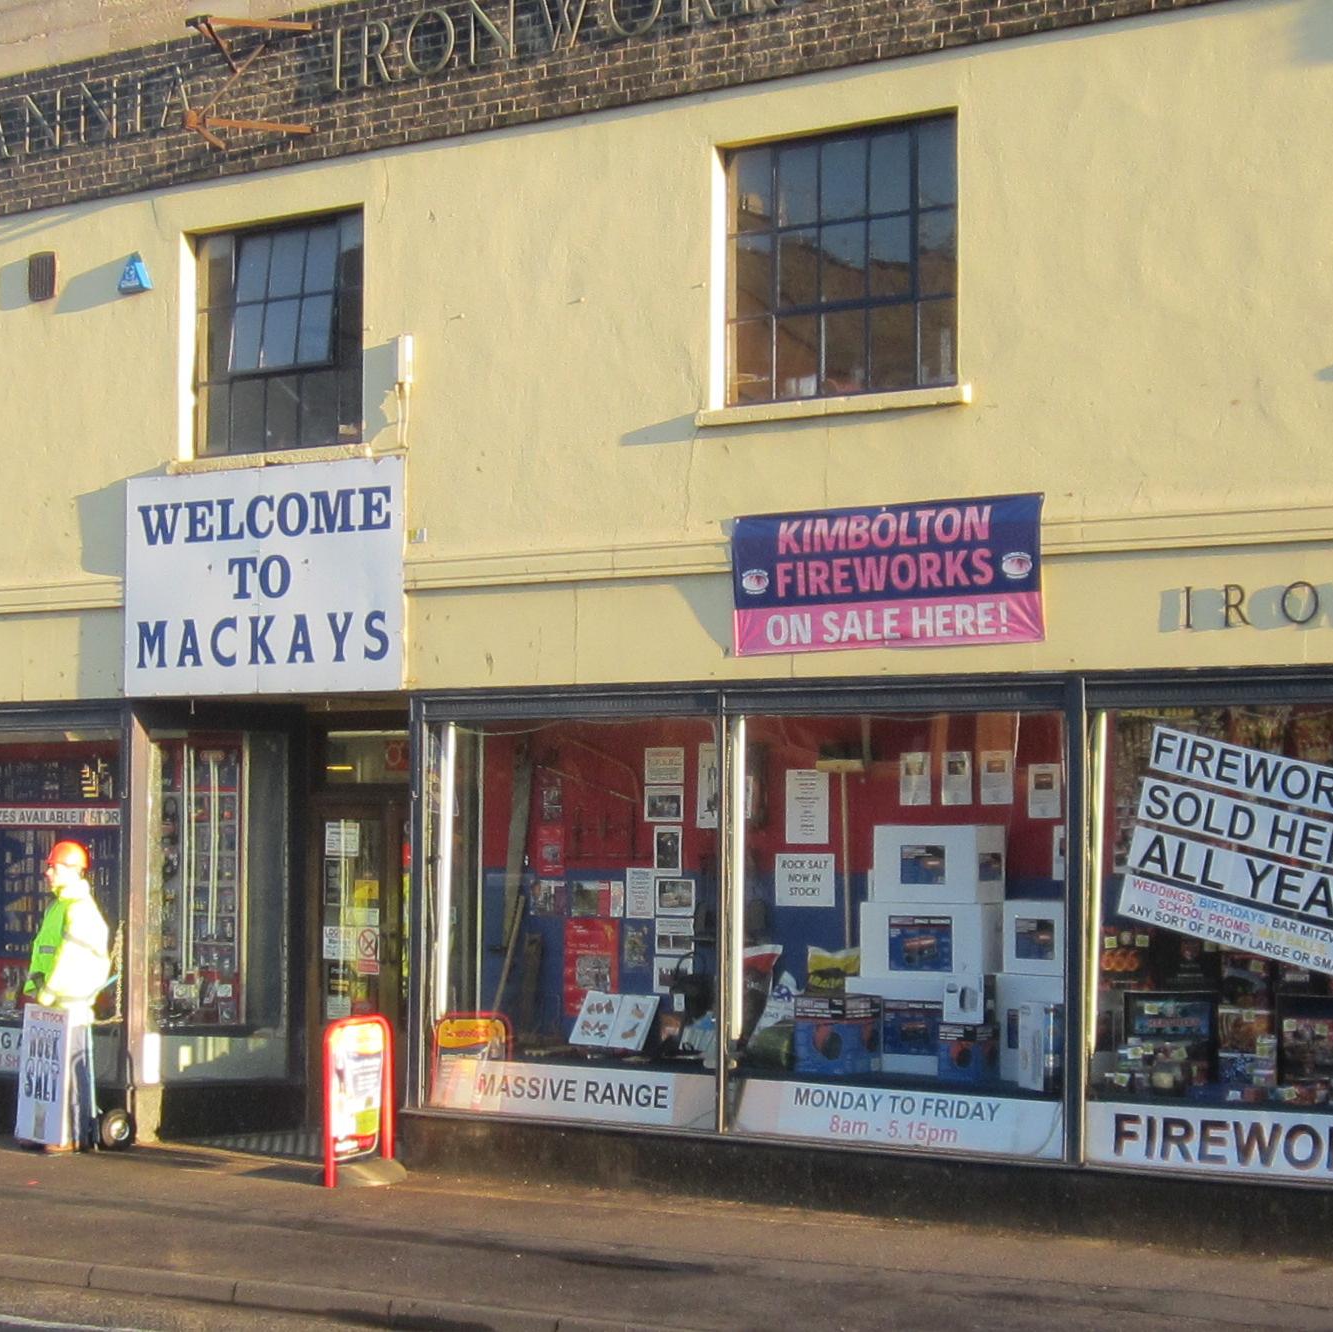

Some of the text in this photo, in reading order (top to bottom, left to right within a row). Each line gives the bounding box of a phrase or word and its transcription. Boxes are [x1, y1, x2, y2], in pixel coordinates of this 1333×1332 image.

[331, 0, 780, 92] IRONWO
[137, 485, 392, 546] WELCOME
[776, 504, 992, 555] KIMBOLTON
[228, 554, 291, 600] TO
[775, 548, 995, 598] FIREWORKS
[136, 609, 390, 669] MACKAYS
[766, 602, 1009, 646] ON SALE HERE!
[19, 810, 77, 823] AVAILABLE
[1145, 784, 1256, 842] SOLD
[781, 859, 829, 869] ROCK SALT
[788, 873, 821, 883] NOW IN
[1138, 834, 1225, 891] ALL
[1132, 878, 1196, 906] WEDDINGS,
[1199, 896, 1268, 928] BIRTHDAYS,
[1271, 916, 1299, 935] BAR
[1157, 898, 1205, 921] SCHOOL
[1128, 903, 1151, 918] ANY
[1154, 910, 1187, 928] SORT
[1188, 920, 1204, 934] OF
[1207, 926, 1247, 948] PARTY
[1248, 937, 1290, 959] LARGE
[1292, 949, 1310, 963] OR
[477, 1073, 669, 1109] MASSIVE RANGE
[794, 1087, 1001, 1122] MONDAY TO FRIDAY
[829, 1114, 869, 1135] 8am
[887, 1120, 958, 1146] 5.15pm
